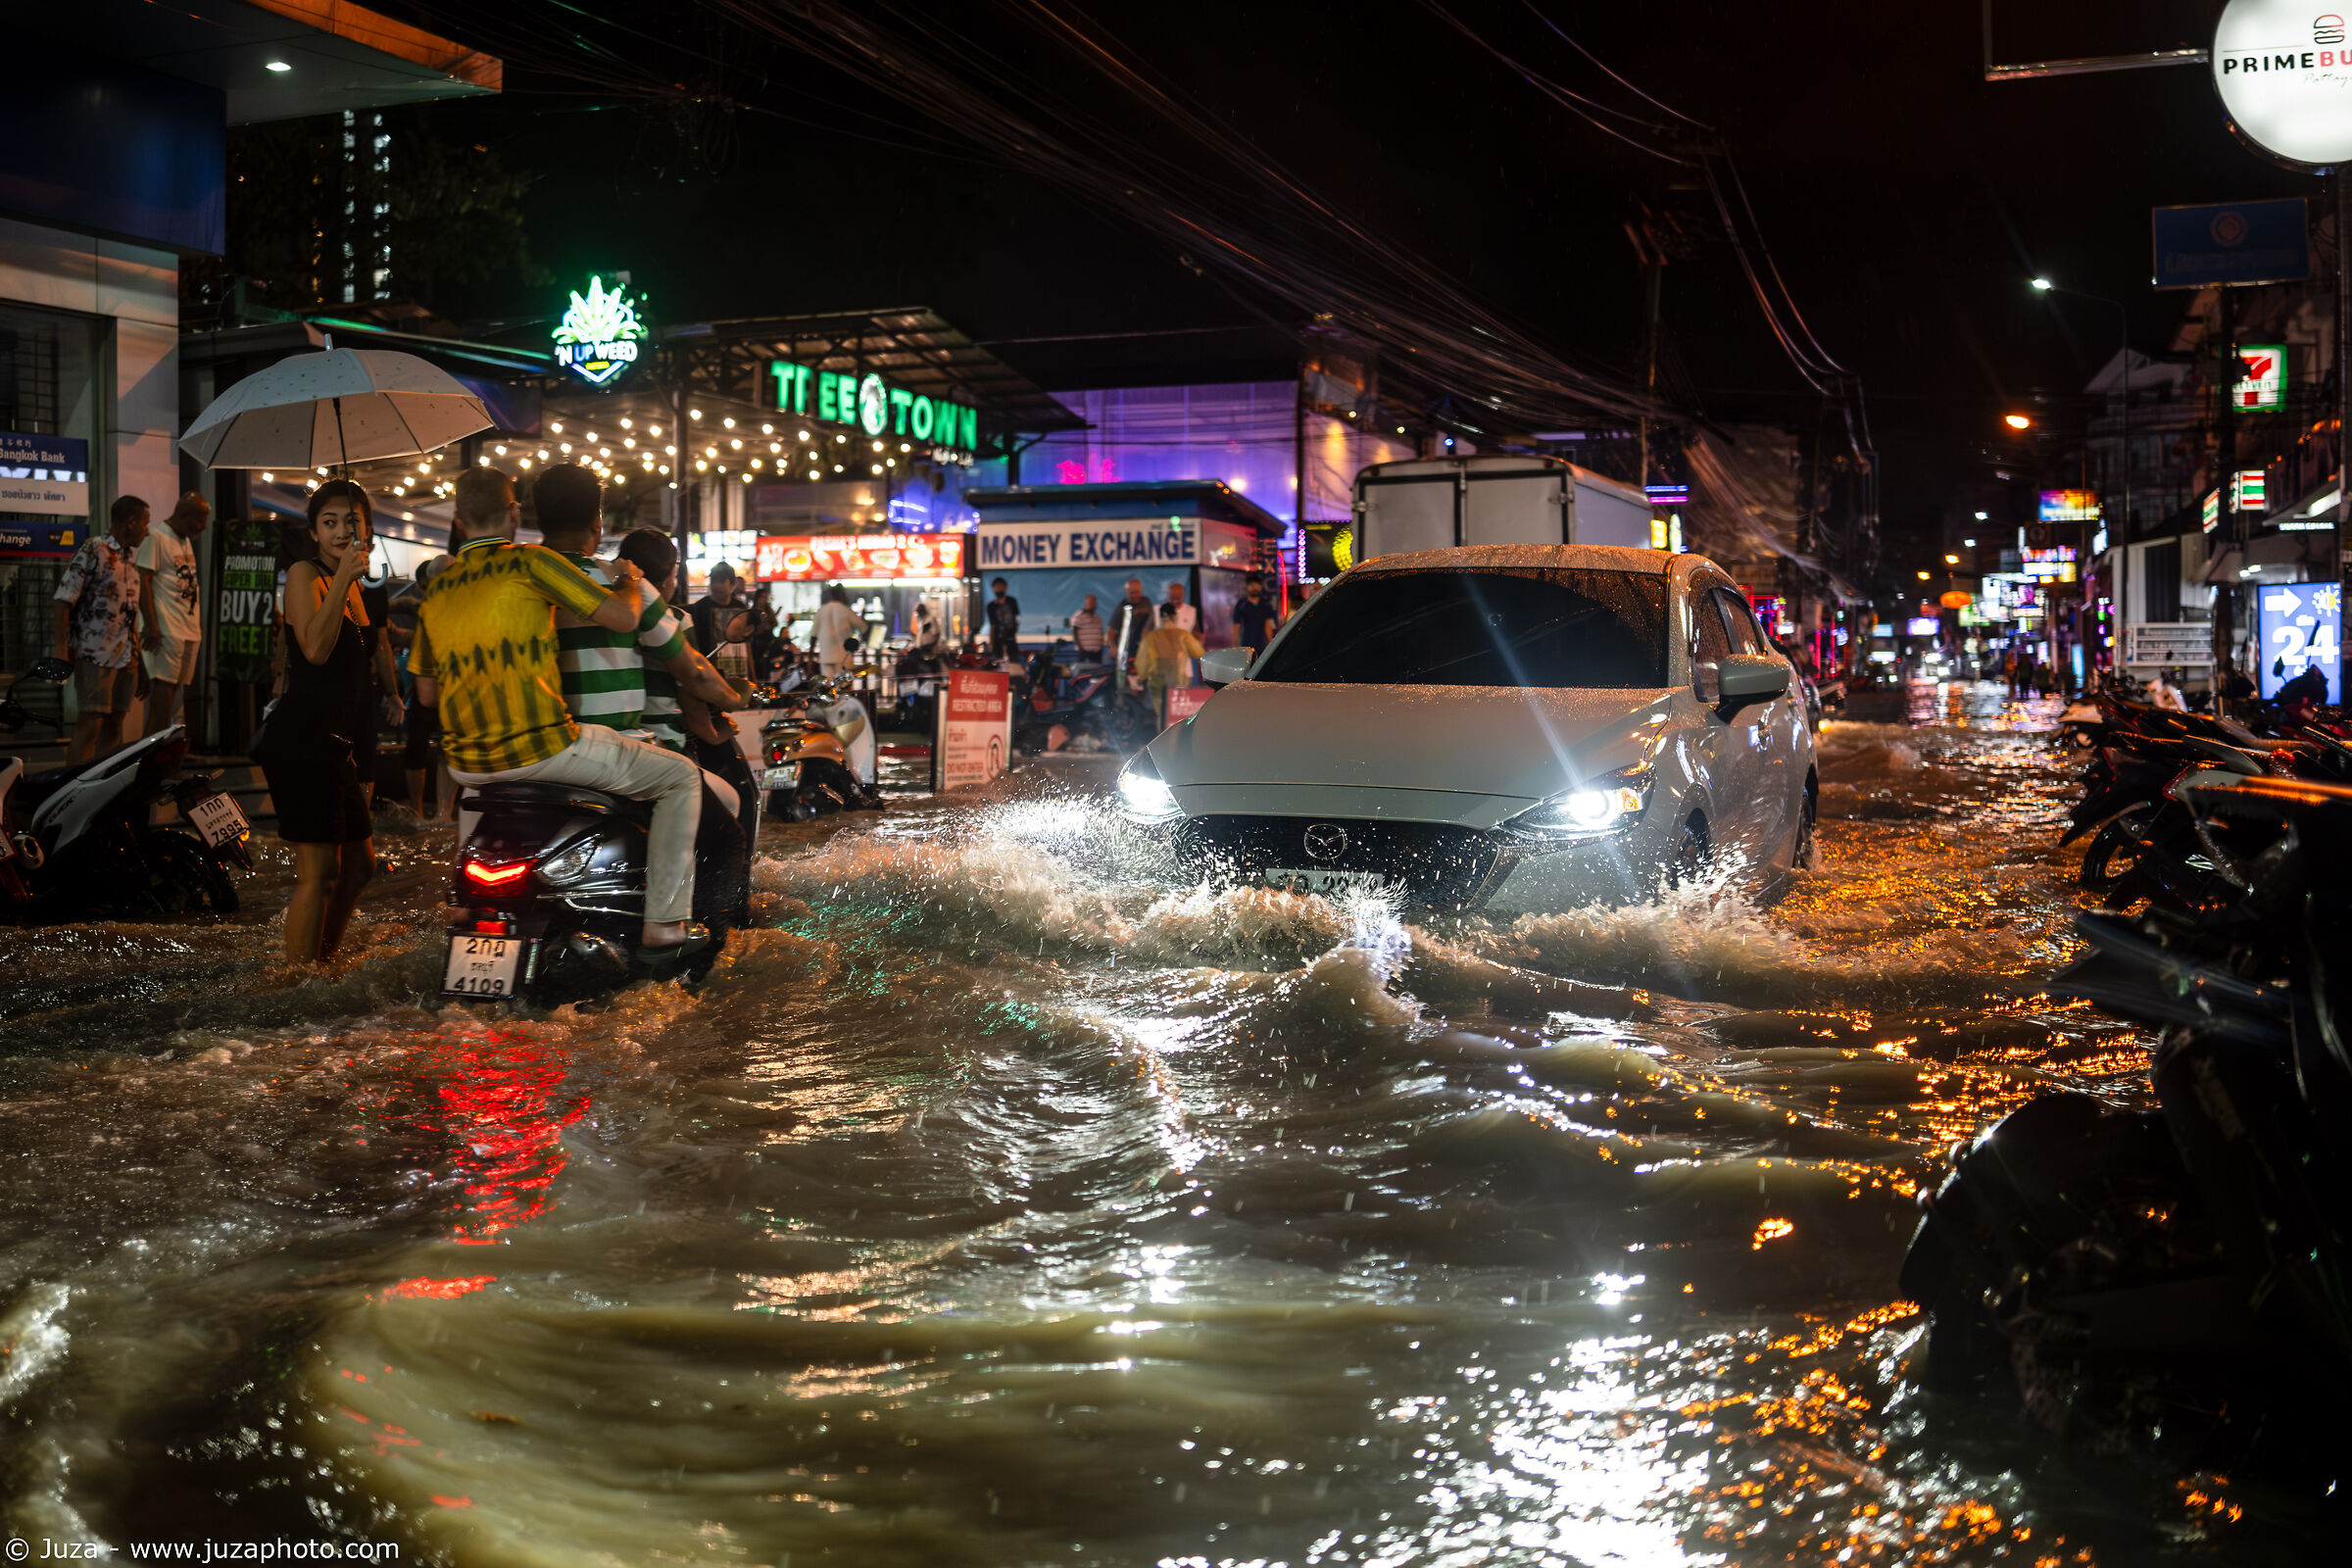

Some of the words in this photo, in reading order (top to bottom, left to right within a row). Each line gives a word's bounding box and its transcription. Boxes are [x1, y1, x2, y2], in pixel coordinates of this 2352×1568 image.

[573, 343, 595, 362] UP
[594, 340, 638, 362] WEED
[890, 388, 977, 451] TOWN
[41, 451, 66, 463] Bank
[982, 534, 1060, 564] MONEY
[1070, 530, 1195, 562] EXCHANGE
[220, 590, 261, 624] BUY
[263, 592, 272, 624] 2
[219, 625, 261, 655] FREE
[2272, 625, 2340, 665] 24
[212, 819, 243, 843] 7995
[454, 976, 505, 995] 4109
